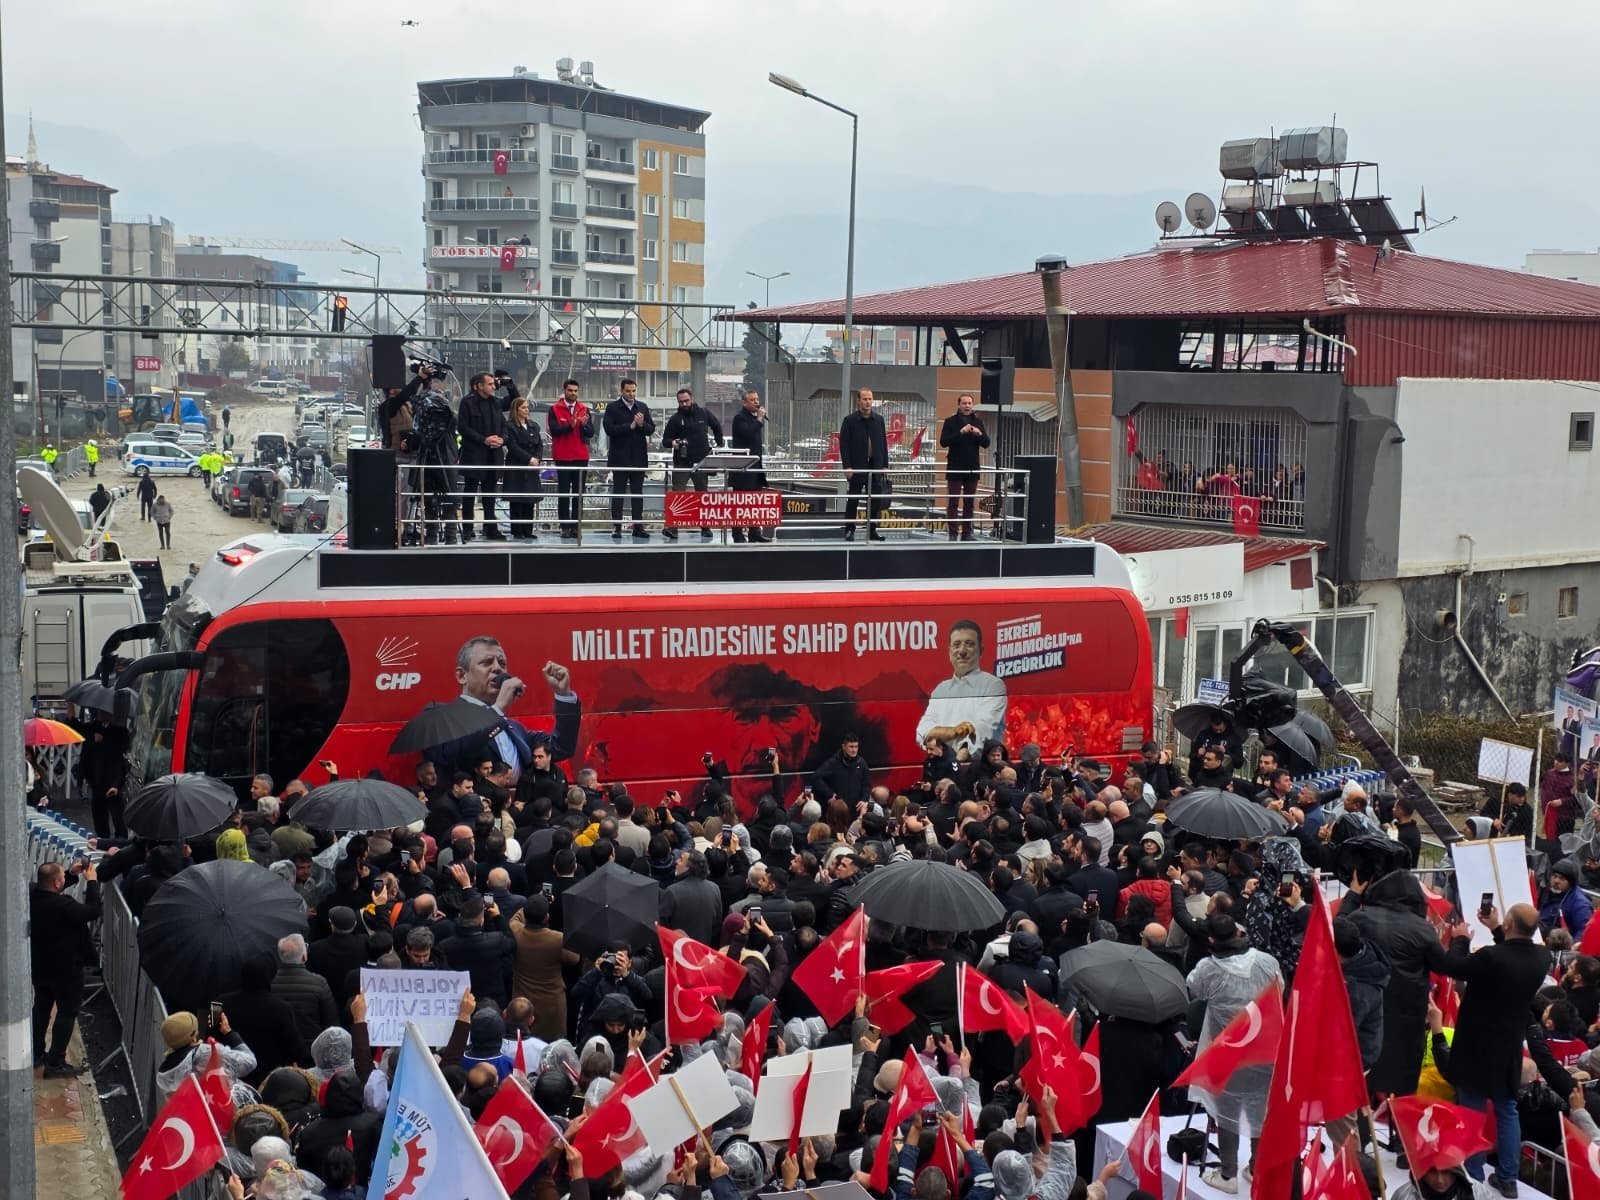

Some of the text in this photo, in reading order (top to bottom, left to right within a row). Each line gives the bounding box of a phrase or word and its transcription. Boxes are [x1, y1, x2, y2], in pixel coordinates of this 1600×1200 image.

[137, 358, 159, 369] BİM
[701, 492, 778, 506] CUMHURİYET
[700, 506, 780, 520] HALK PARTİSİ
[1168, 590, 1233, 605] 0 535 815 18 09
[572, 620, 938, 661] MİLLET İRADESİNE SAHİP ÇIKIYOR
[997, 621, 1042, 643] EKREM
[997, 631, 1083, 660] İMAMOĞLU'NA
[996, 651, 1063, 678] ÖZGÜRLÜK
[375, 672, 422, 691] CHP
